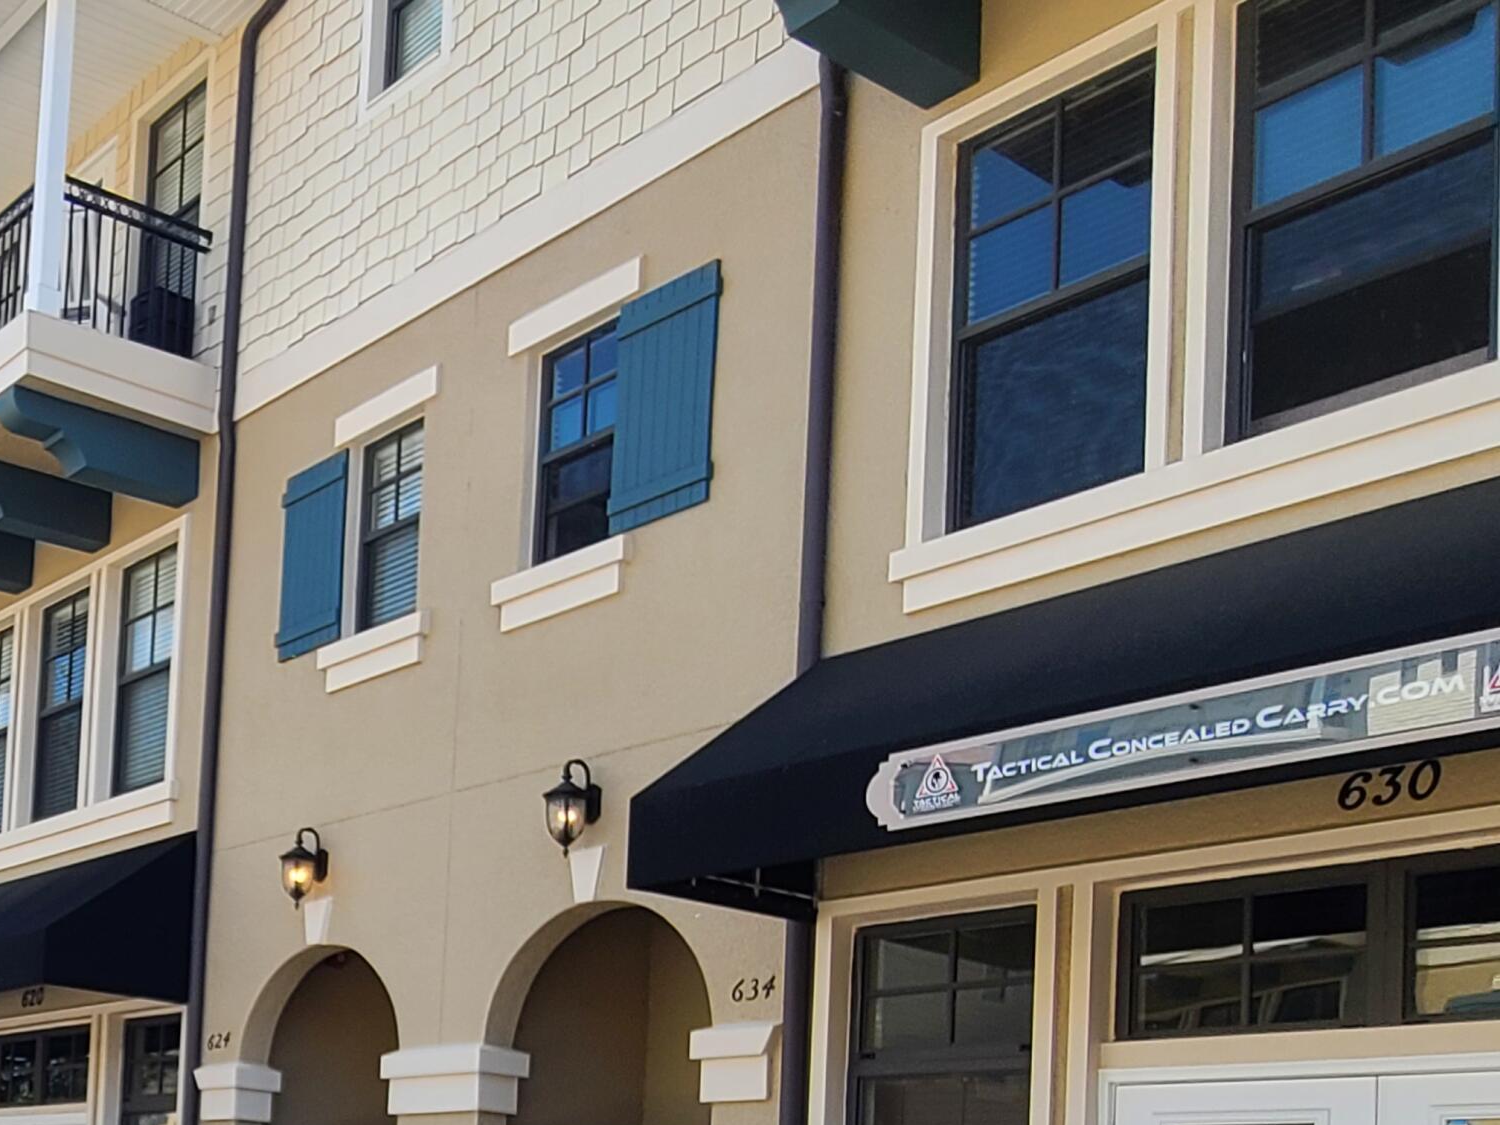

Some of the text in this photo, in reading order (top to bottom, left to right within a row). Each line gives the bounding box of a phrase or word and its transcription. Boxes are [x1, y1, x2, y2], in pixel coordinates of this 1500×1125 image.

[972, 750, 1084, 783] TACTICAL
[1088, 717, 1250, 760] CONCEALED
[1337, 759, 1442, 812] 630
[731, 975, 776, 1002] 634
[207, 1031, 231, 1051] 624
